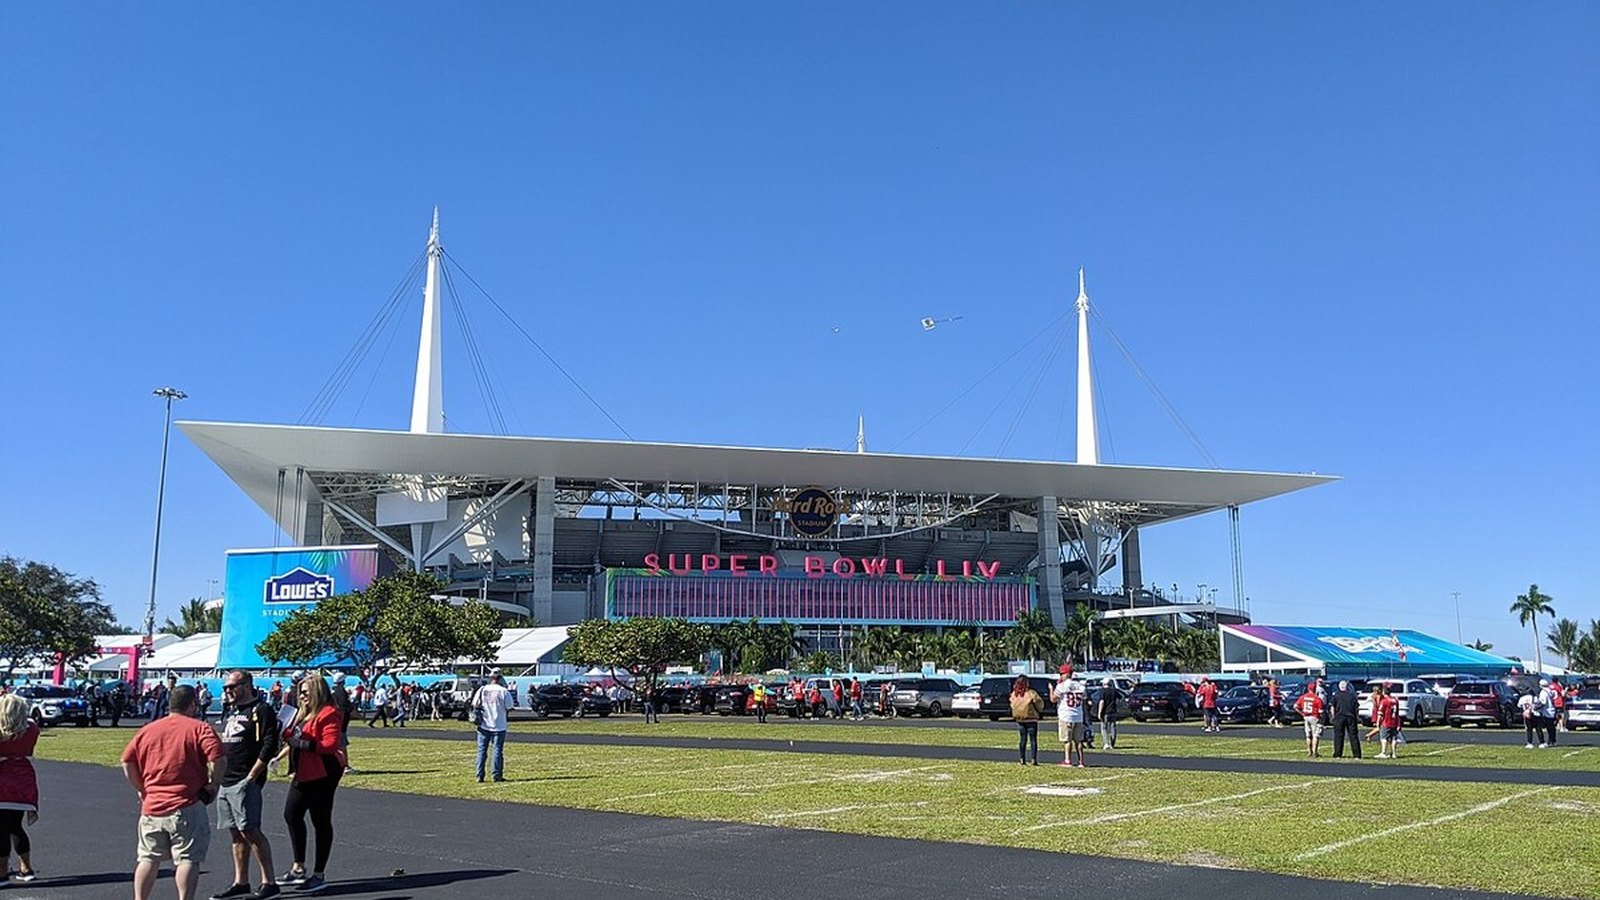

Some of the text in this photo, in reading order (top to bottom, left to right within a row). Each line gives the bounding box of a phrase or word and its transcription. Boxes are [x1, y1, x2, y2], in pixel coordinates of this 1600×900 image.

[644, 553, 1001, 581] SUPER BOWL LIV
[271, 581, 329, 600] LOWE'S
[1067, 692, 1083, 707] 85
[1303, 702, 1313, 713] 15
